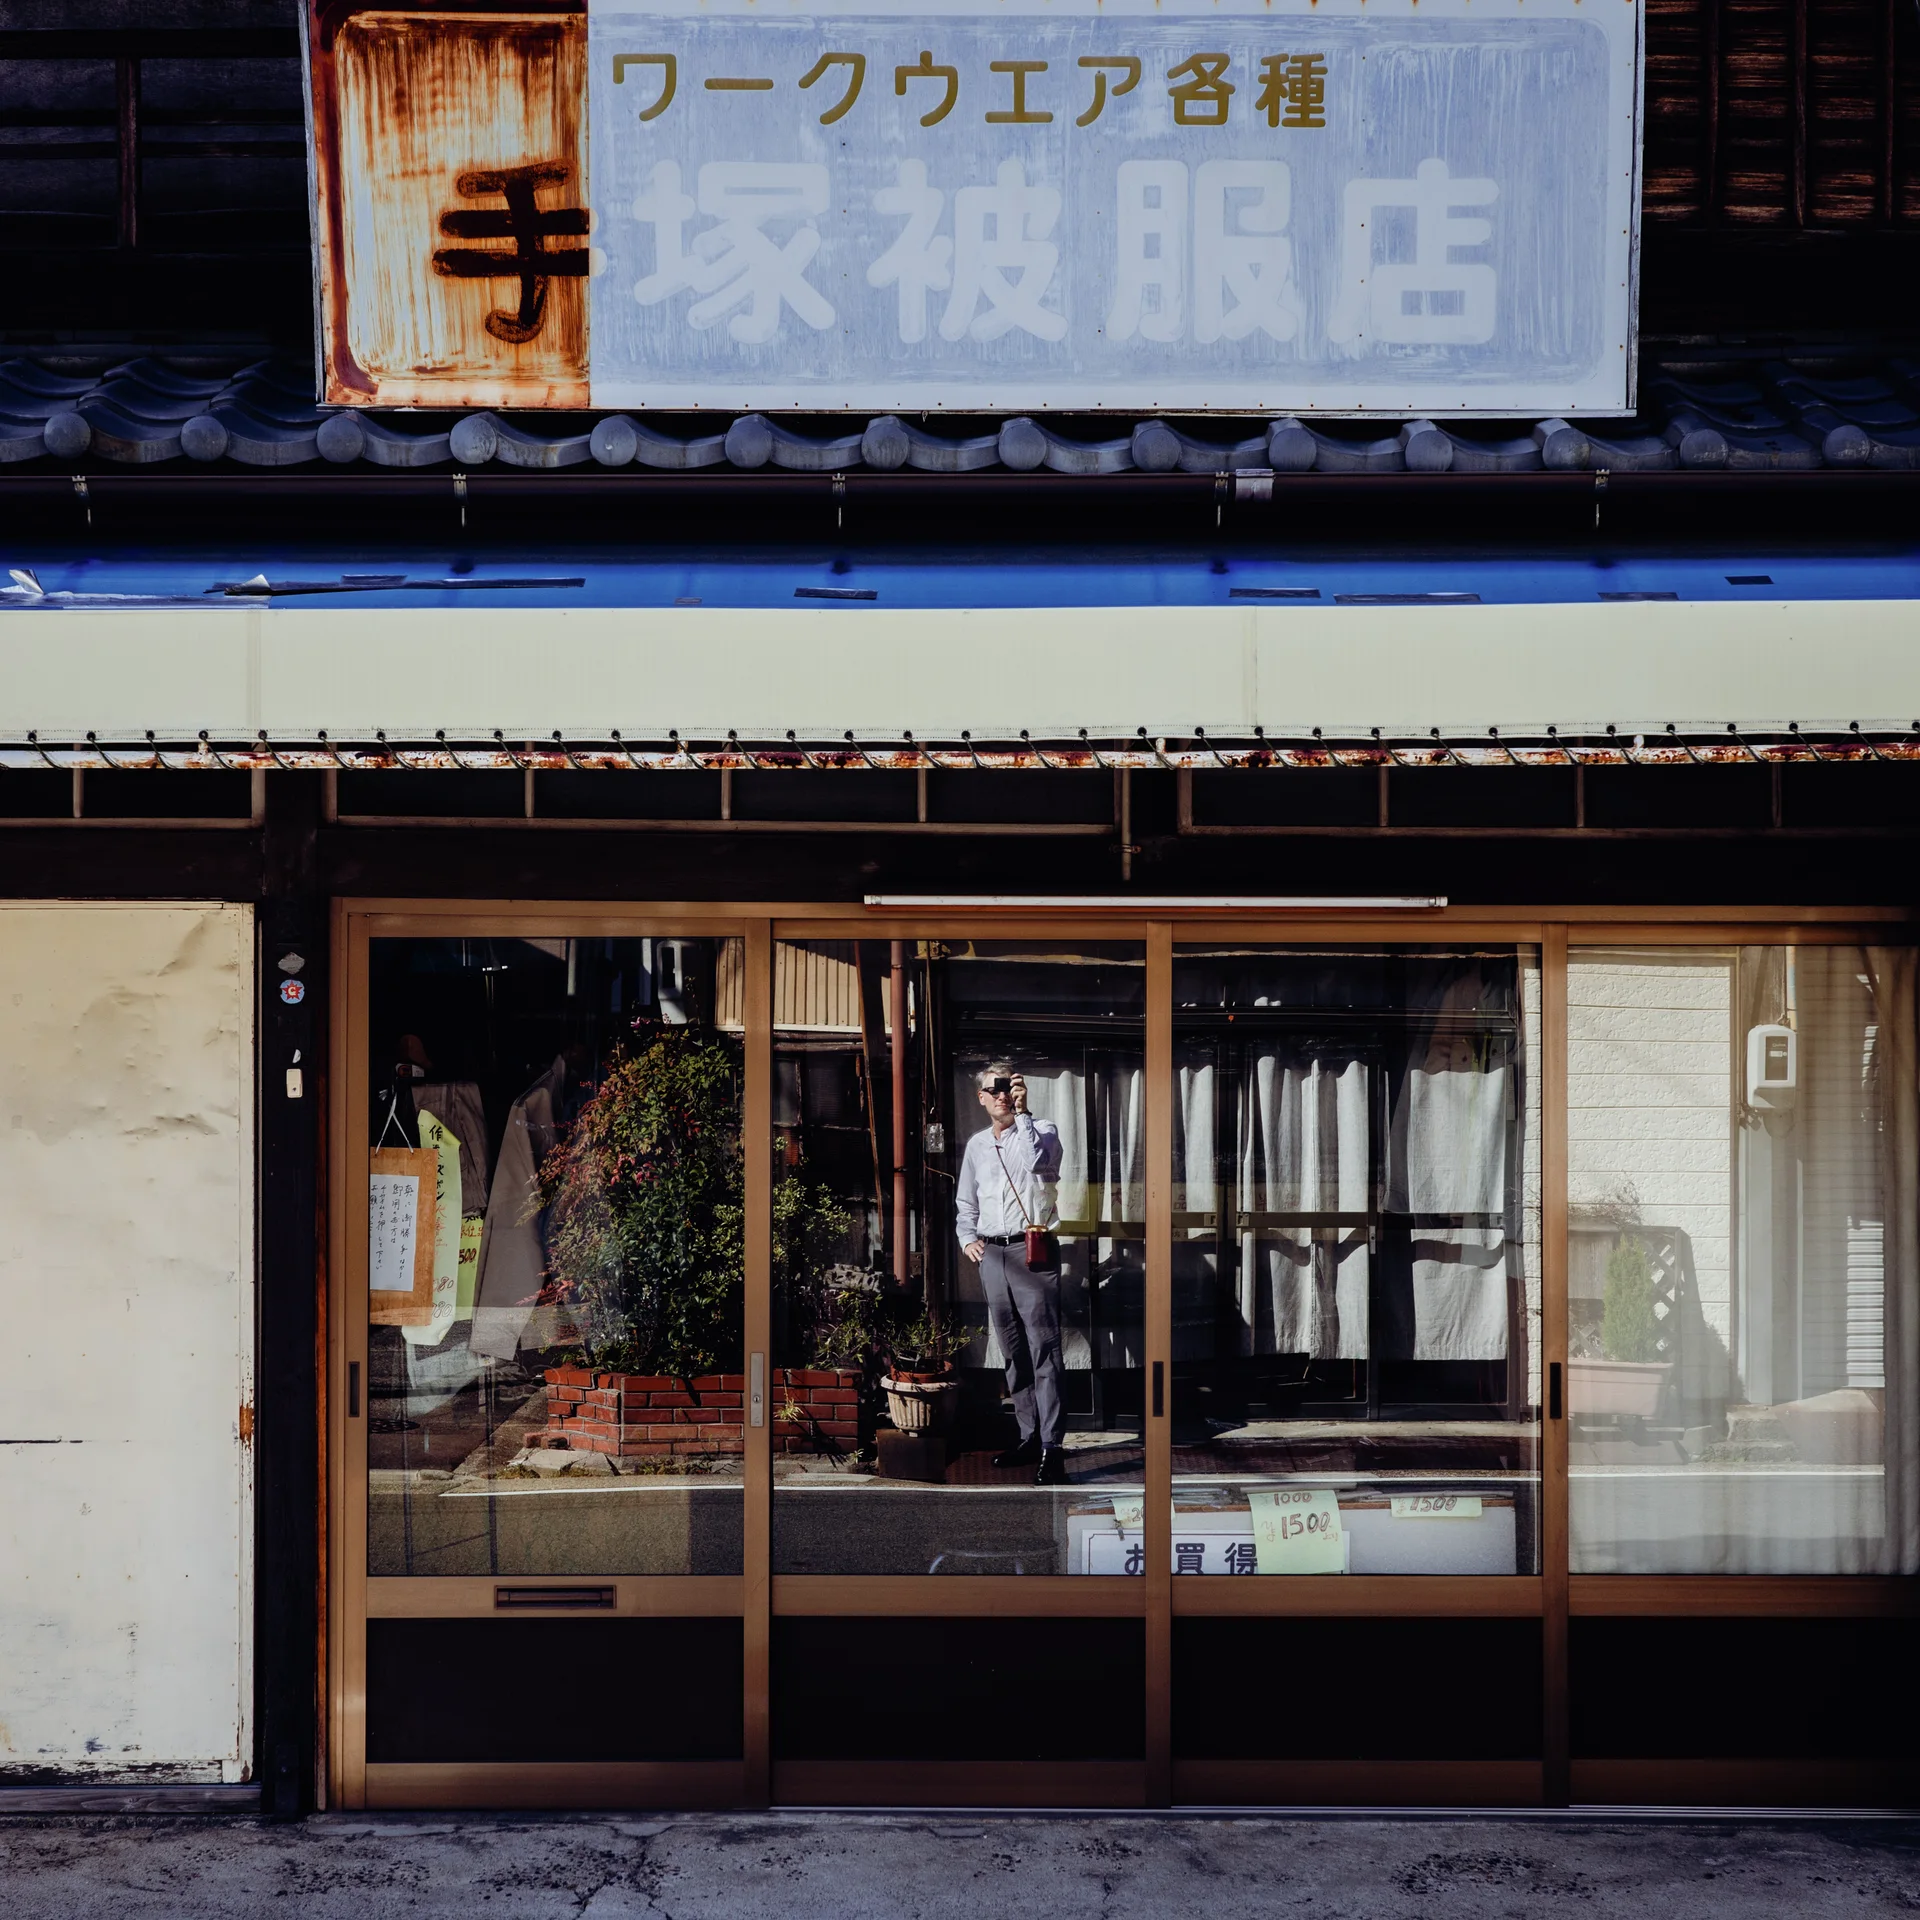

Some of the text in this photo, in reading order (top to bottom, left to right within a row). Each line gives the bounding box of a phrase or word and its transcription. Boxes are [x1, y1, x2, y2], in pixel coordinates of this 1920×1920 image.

[612, 50, 1328, 128] ワークウエア各種
[432, 157, 1500, 345] 手塚被服店
[1274, 1492, 1313, 1506] 1000
[1410, 1495, 1458, 1512] 1500
[1281, 1511, 1331, 1540] 1500
